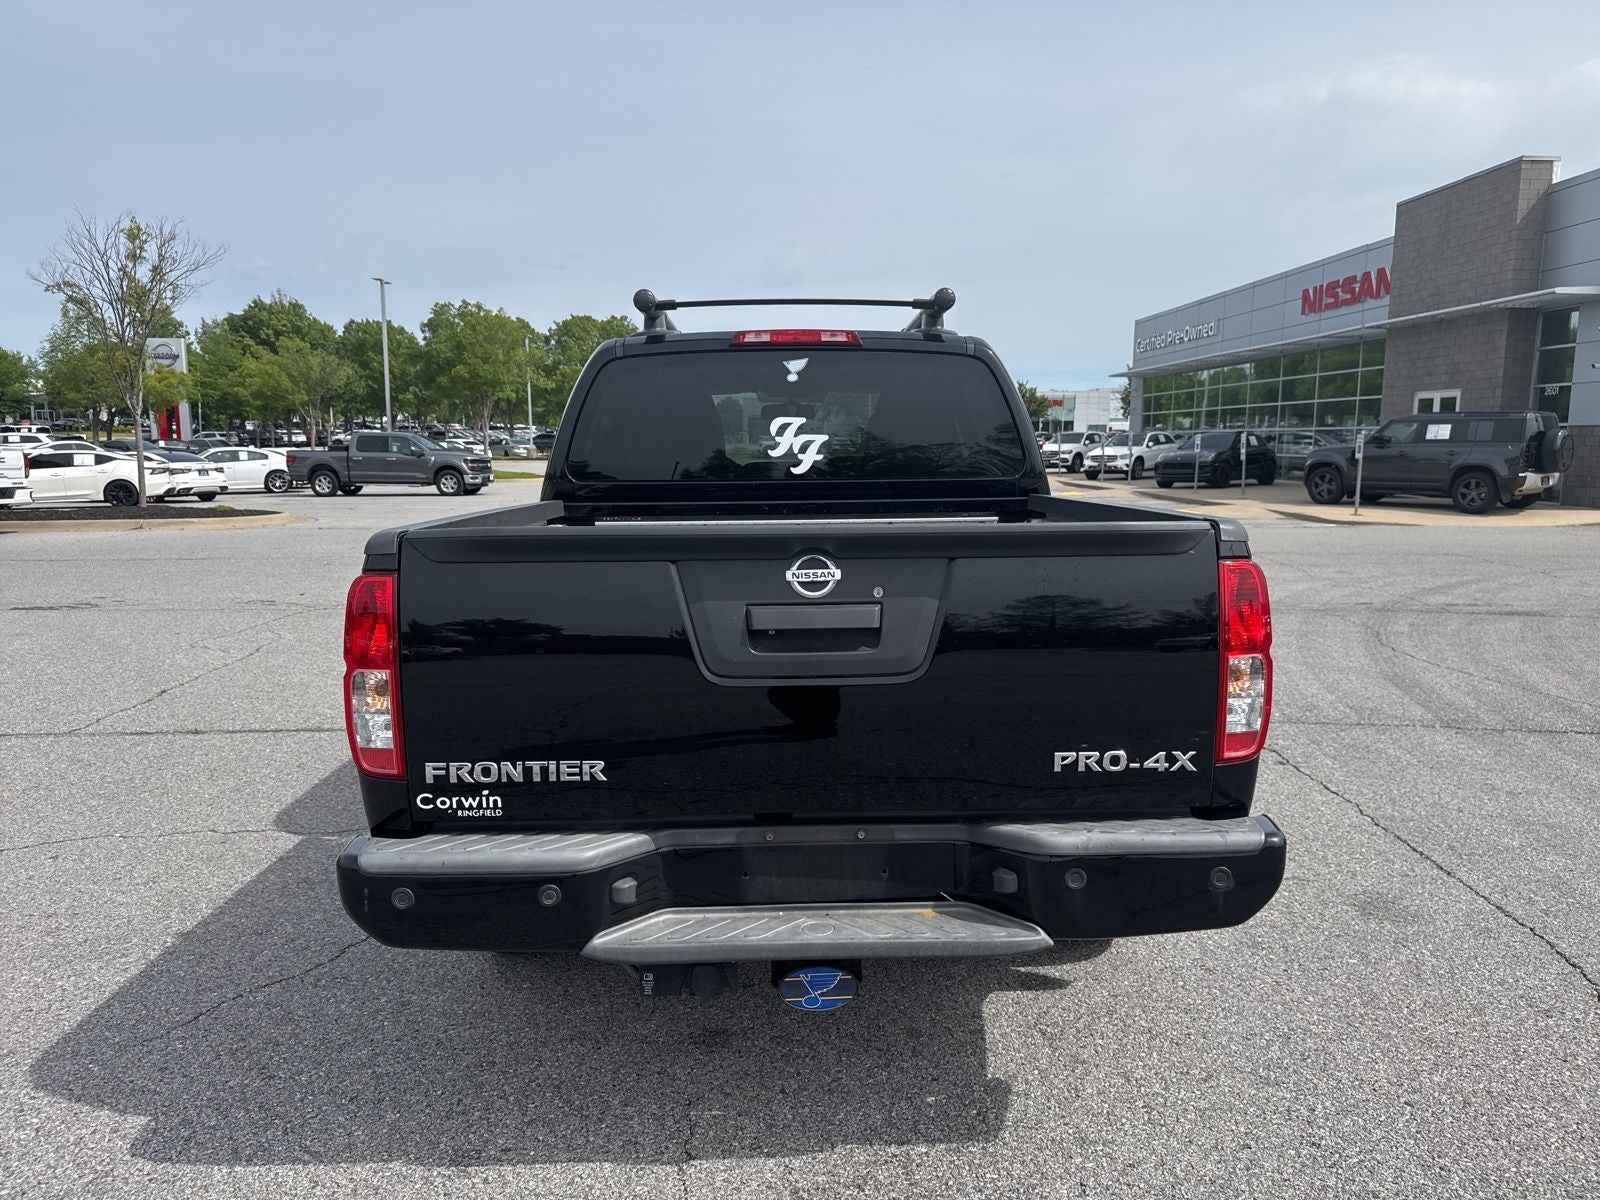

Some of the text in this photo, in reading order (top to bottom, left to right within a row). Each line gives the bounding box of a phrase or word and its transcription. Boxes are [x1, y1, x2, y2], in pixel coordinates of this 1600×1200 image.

[1300, 266, 1391, 315] NISSAN
[1136, 317, 1215, 353] Certified Pre-Owned
[1545, 385, 1559, 395] 2601
[791, 571, 836, 580] NISSAN
[424, 760, 608, 784] FRONTIER
[1053, 750, 1198, 773] PRO-4X
[416, 789, 502, 810] Corwin
